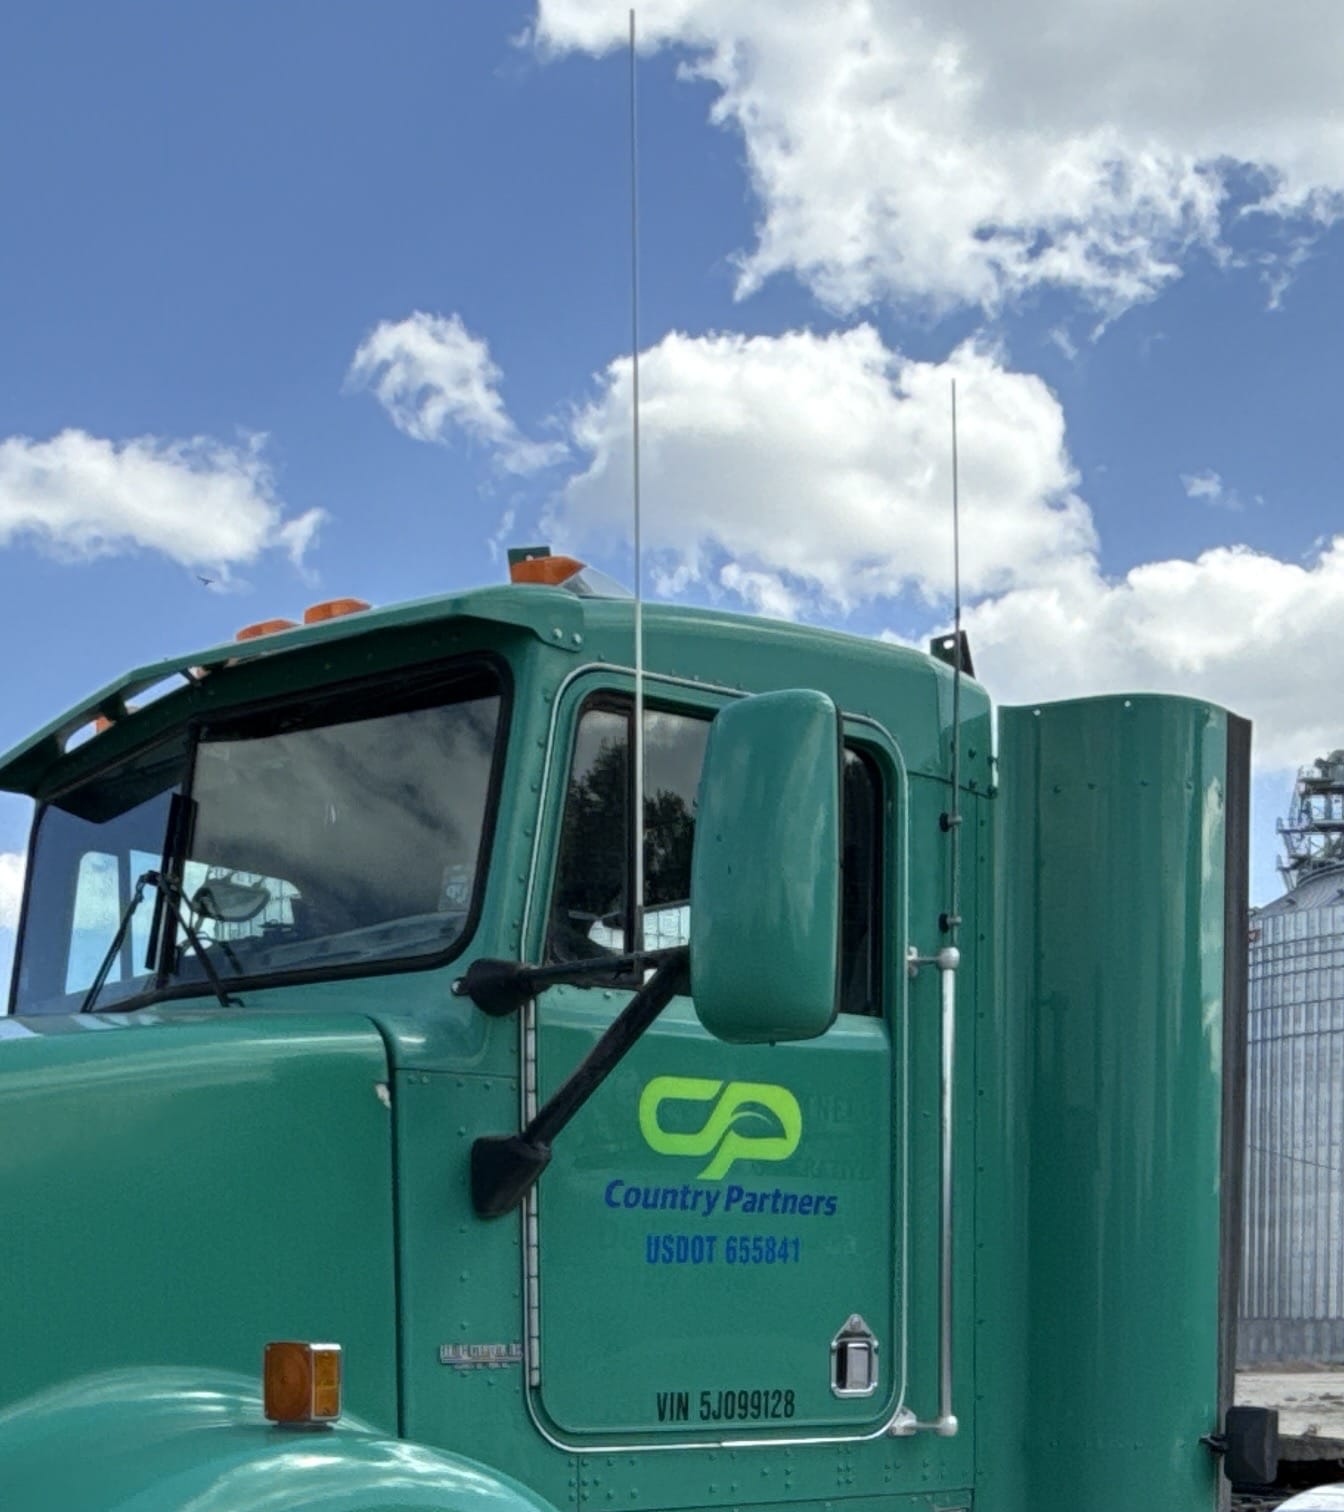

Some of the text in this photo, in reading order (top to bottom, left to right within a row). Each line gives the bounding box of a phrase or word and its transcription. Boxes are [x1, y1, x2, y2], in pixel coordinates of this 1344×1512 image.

[605, 1180, 838, 1217] Country Partners
[647, 1234, 801, 1264] USDOT 655841
[656, 1389, 796, 1422] VIN 5J099128
